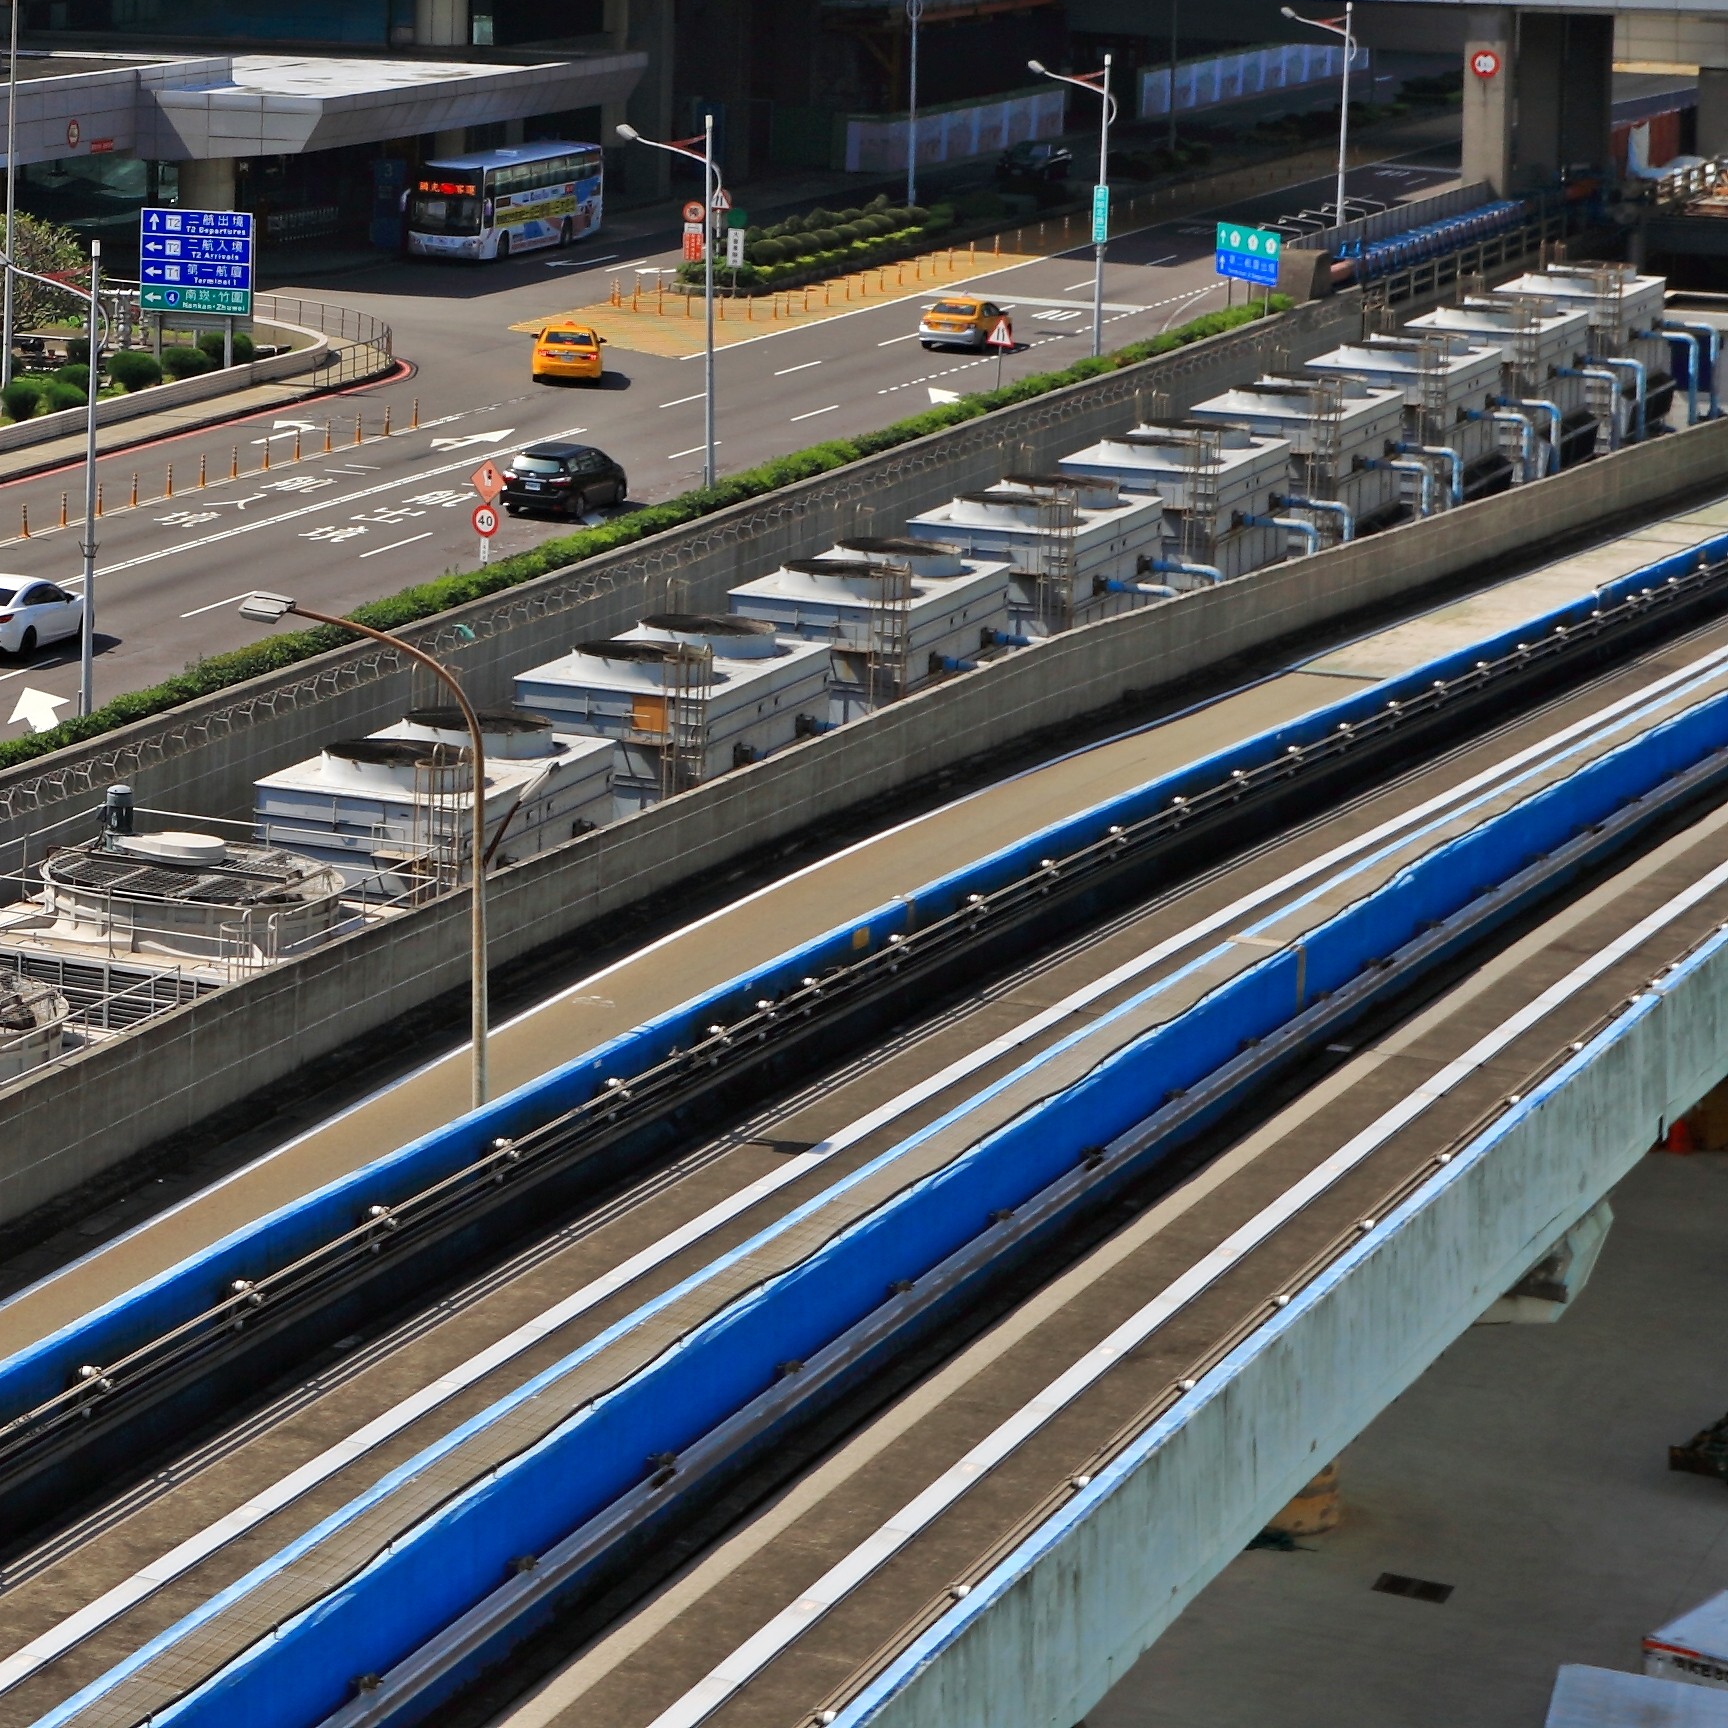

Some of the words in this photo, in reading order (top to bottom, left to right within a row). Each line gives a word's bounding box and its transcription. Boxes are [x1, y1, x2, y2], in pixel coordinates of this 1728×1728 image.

[167, 217, 181, 229] T2
[188, 214, 244, 228] 二航出境
[186, 225, 196, 233] T2
[198, 226, 246, 236] Departures
[167, 242, 181, 254] T2
[187, 239, 243, 253] 二航入境
[191, 251, 201, 259] T2
[204, 253, 239, 261] Arrivals
[167, 268, 180, 280] T1
[194, 277, 231, 286] Terminal
[168, 293, 176, 302] 4
[477, 515, 493, 527] 40
